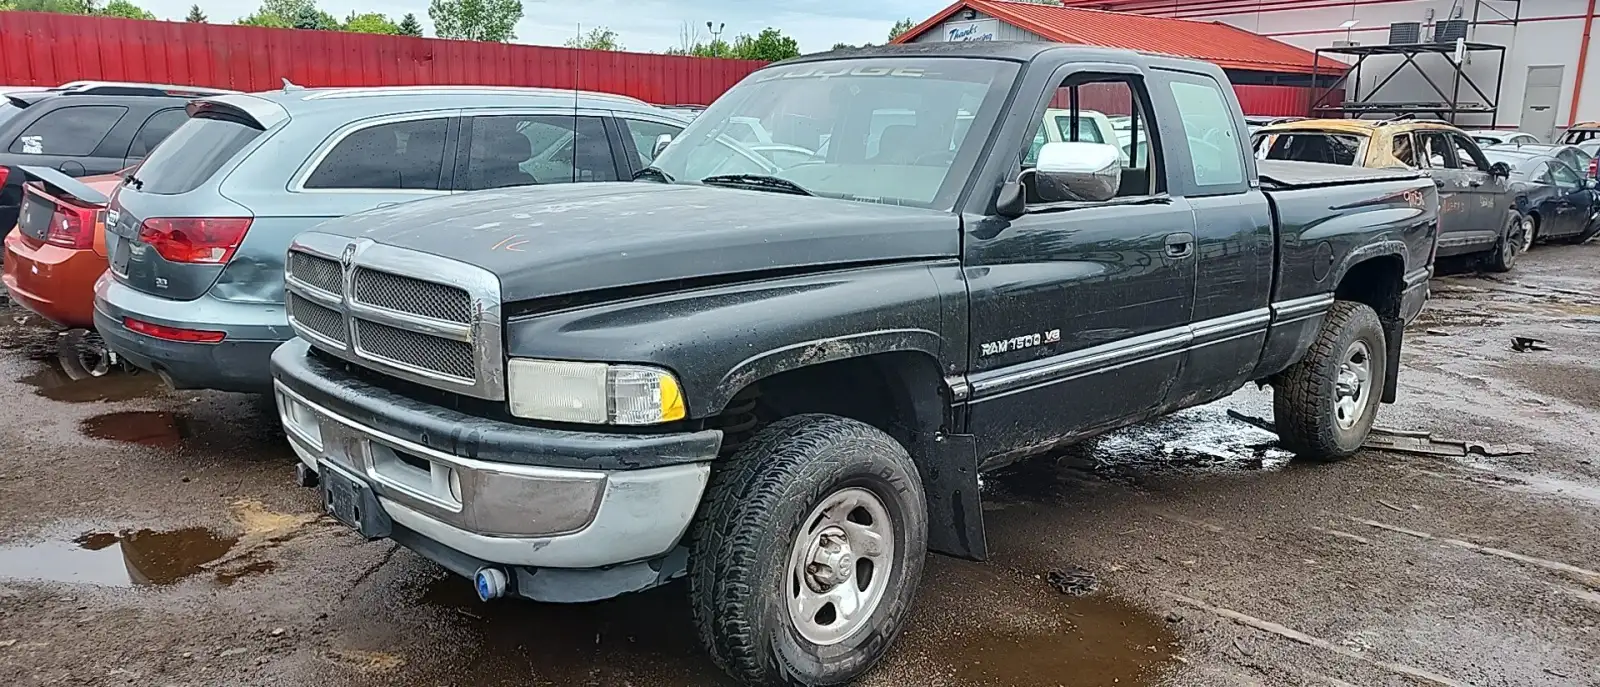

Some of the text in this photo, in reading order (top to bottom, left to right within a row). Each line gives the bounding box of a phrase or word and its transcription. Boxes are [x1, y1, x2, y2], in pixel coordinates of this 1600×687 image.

[949, 24, 977, 42] Thanks
[980, 329, 1060, 356] RAM 1500 V8
